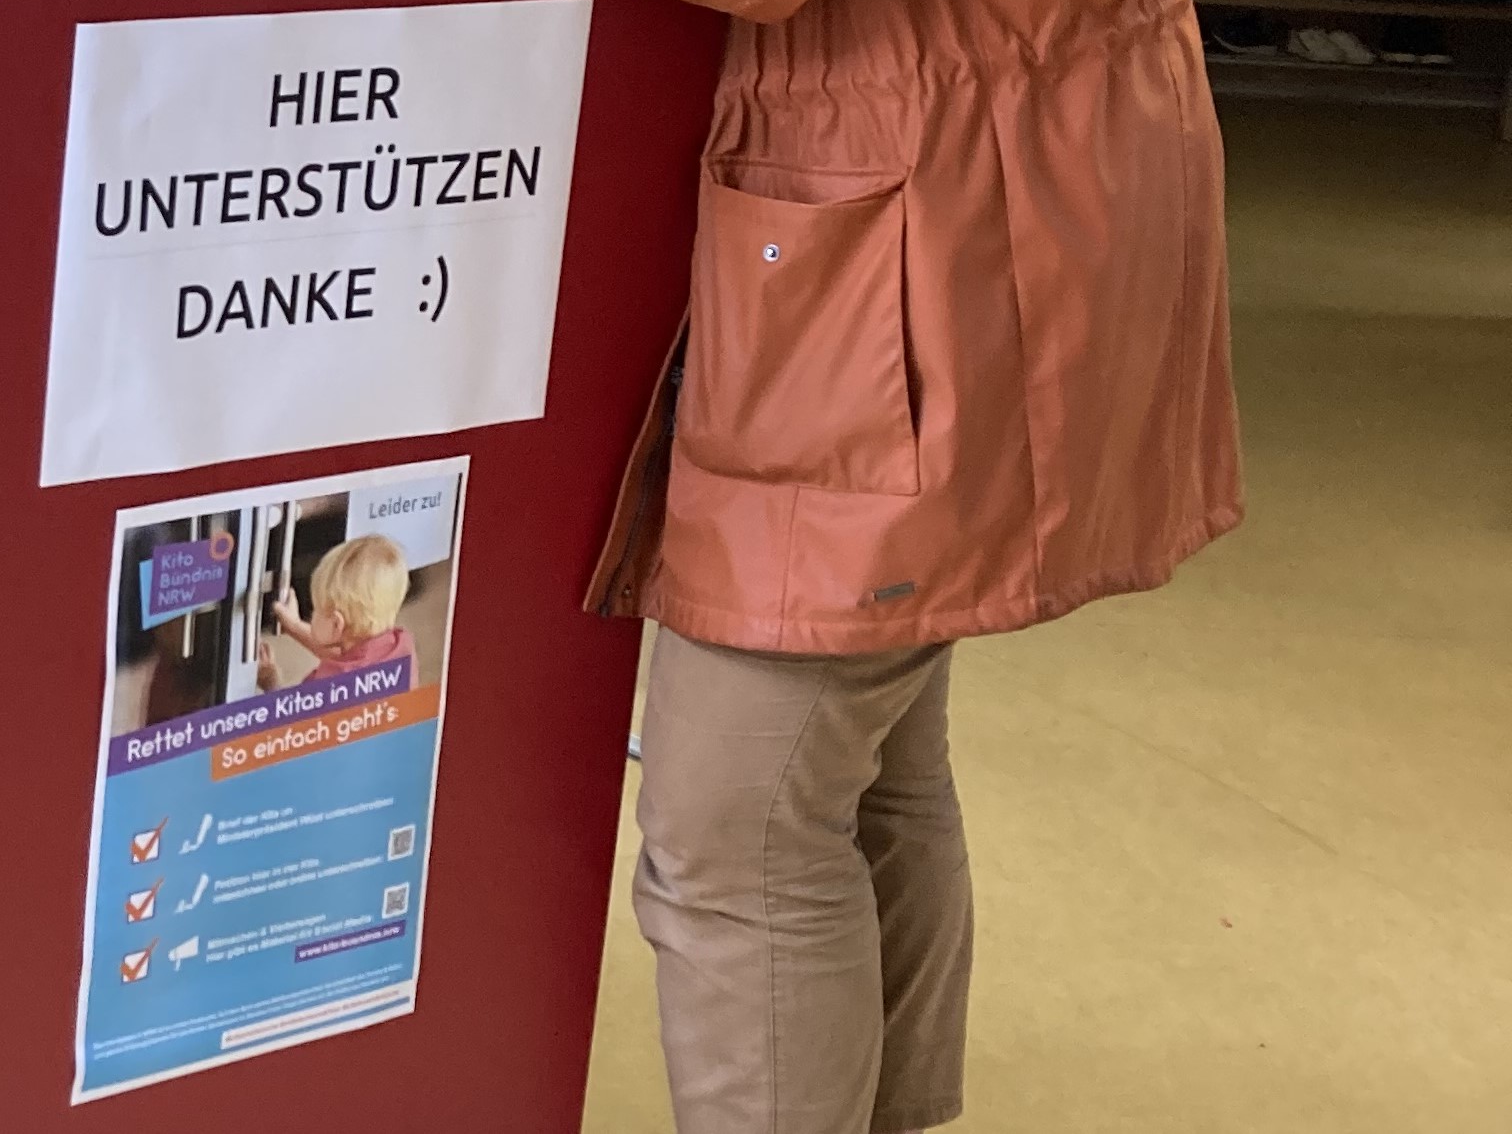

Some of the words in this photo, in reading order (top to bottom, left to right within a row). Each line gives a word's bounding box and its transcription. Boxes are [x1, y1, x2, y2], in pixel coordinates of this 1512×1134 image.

[269, 67, 400, 128] HIER
[95, 145, 541, 237] UNTERSTÜTZEN
[176, 267, 376, 339] DANKE
[369, 498, 418, 519] Leider
[421, 491, 442, 510] zu!
[159, 565, 223, 589] Bündnis
[161, 553, 194, 570] Kita
[158, 588, 196, 607] NRW
[127, 726, 194, 763] Rettet
[200, 707, 269, 739] unsere
[275, 690, 324, 720] Kitas
[330, 682, 348, 704] in
[354, 665, 402, 697] NRW
[221, 747, 247, 769] So
[253, 721, 330, 759] einfach
